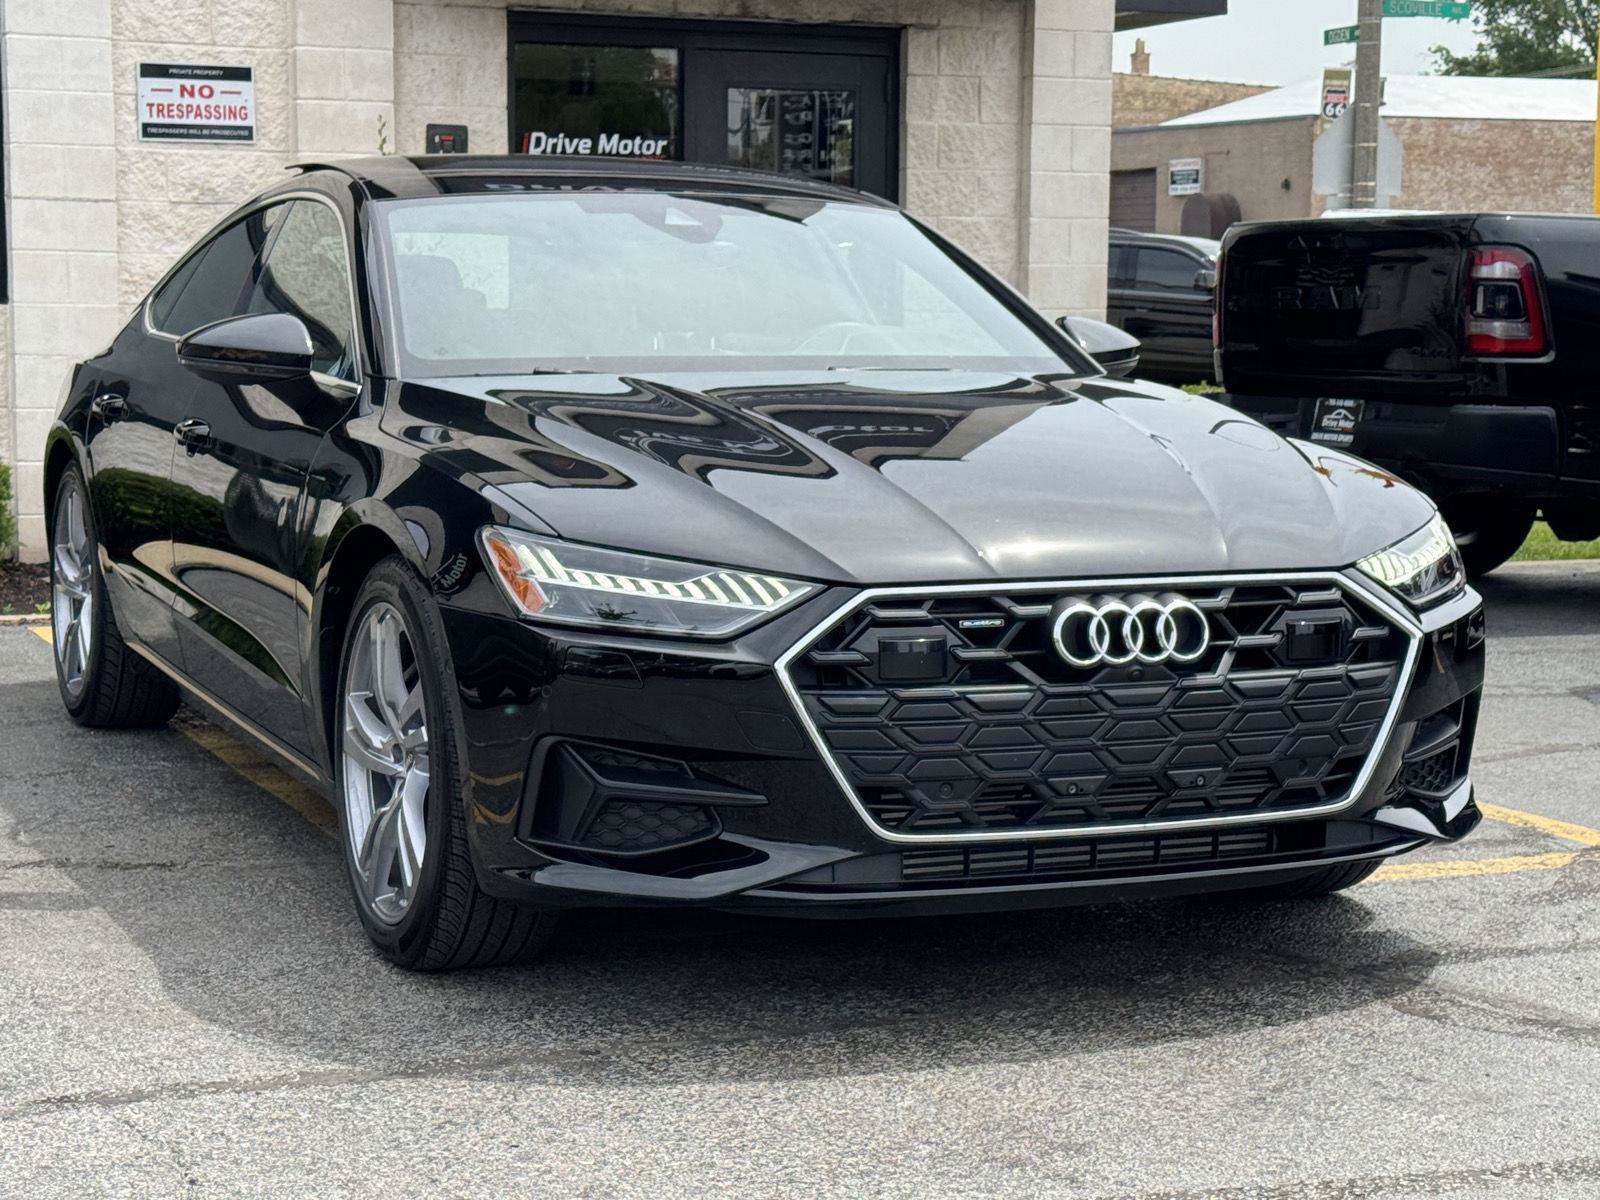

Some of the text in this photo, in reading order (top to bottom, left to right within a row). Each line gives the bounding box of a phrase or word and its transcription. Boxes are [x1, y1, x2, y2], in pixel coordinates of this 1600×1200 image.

[1390, 1, 1442, 15] SCOVILLE
[179, 84, 214, 99] NO
[146, 103, 248, 121] TRESPASSING
[1325, 102, 1345, 116] 66
[598, 133, 668, 156] Motor
